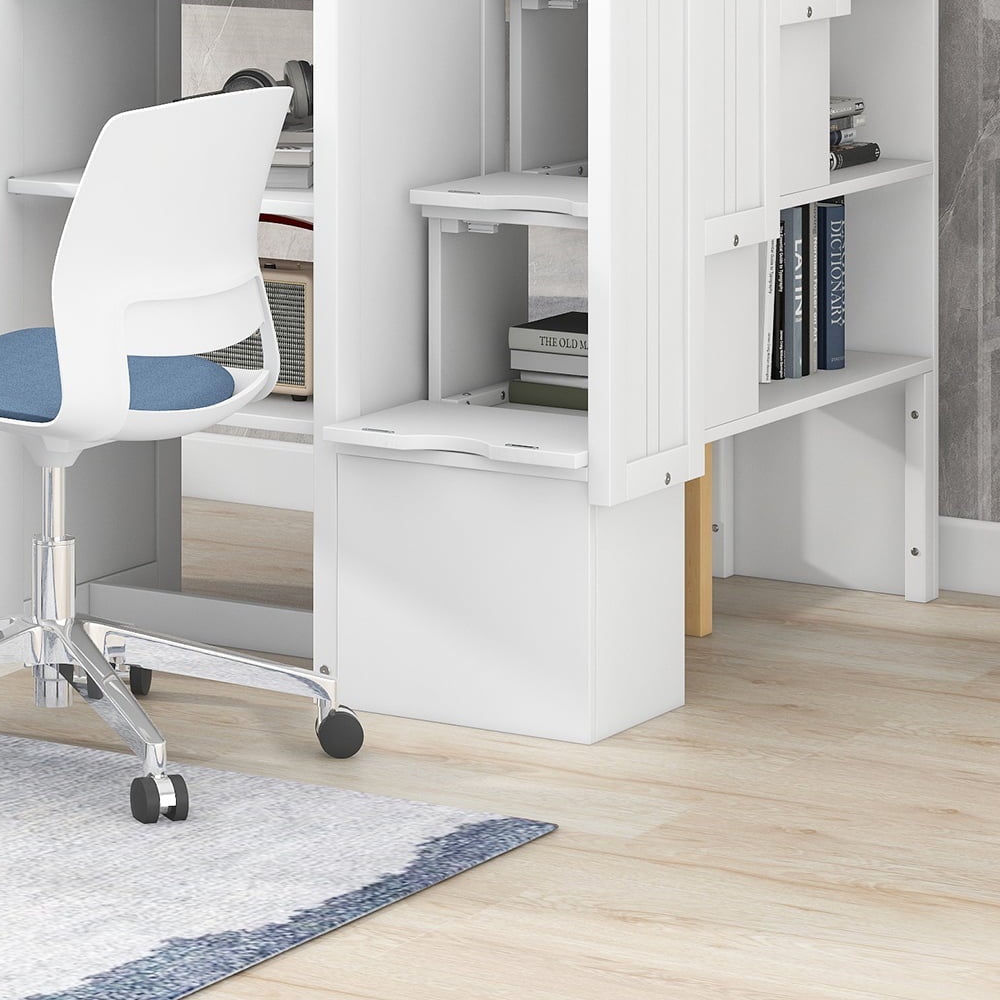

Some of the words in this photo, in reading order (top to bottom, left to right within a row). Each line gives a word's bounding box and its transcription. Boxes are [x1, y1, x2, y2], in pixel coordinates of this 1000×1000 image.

[831, 220, 842, 326] DICTIONARY
[539, 335, 558, 347] THE
[559, 337, 578, 349] OLD
